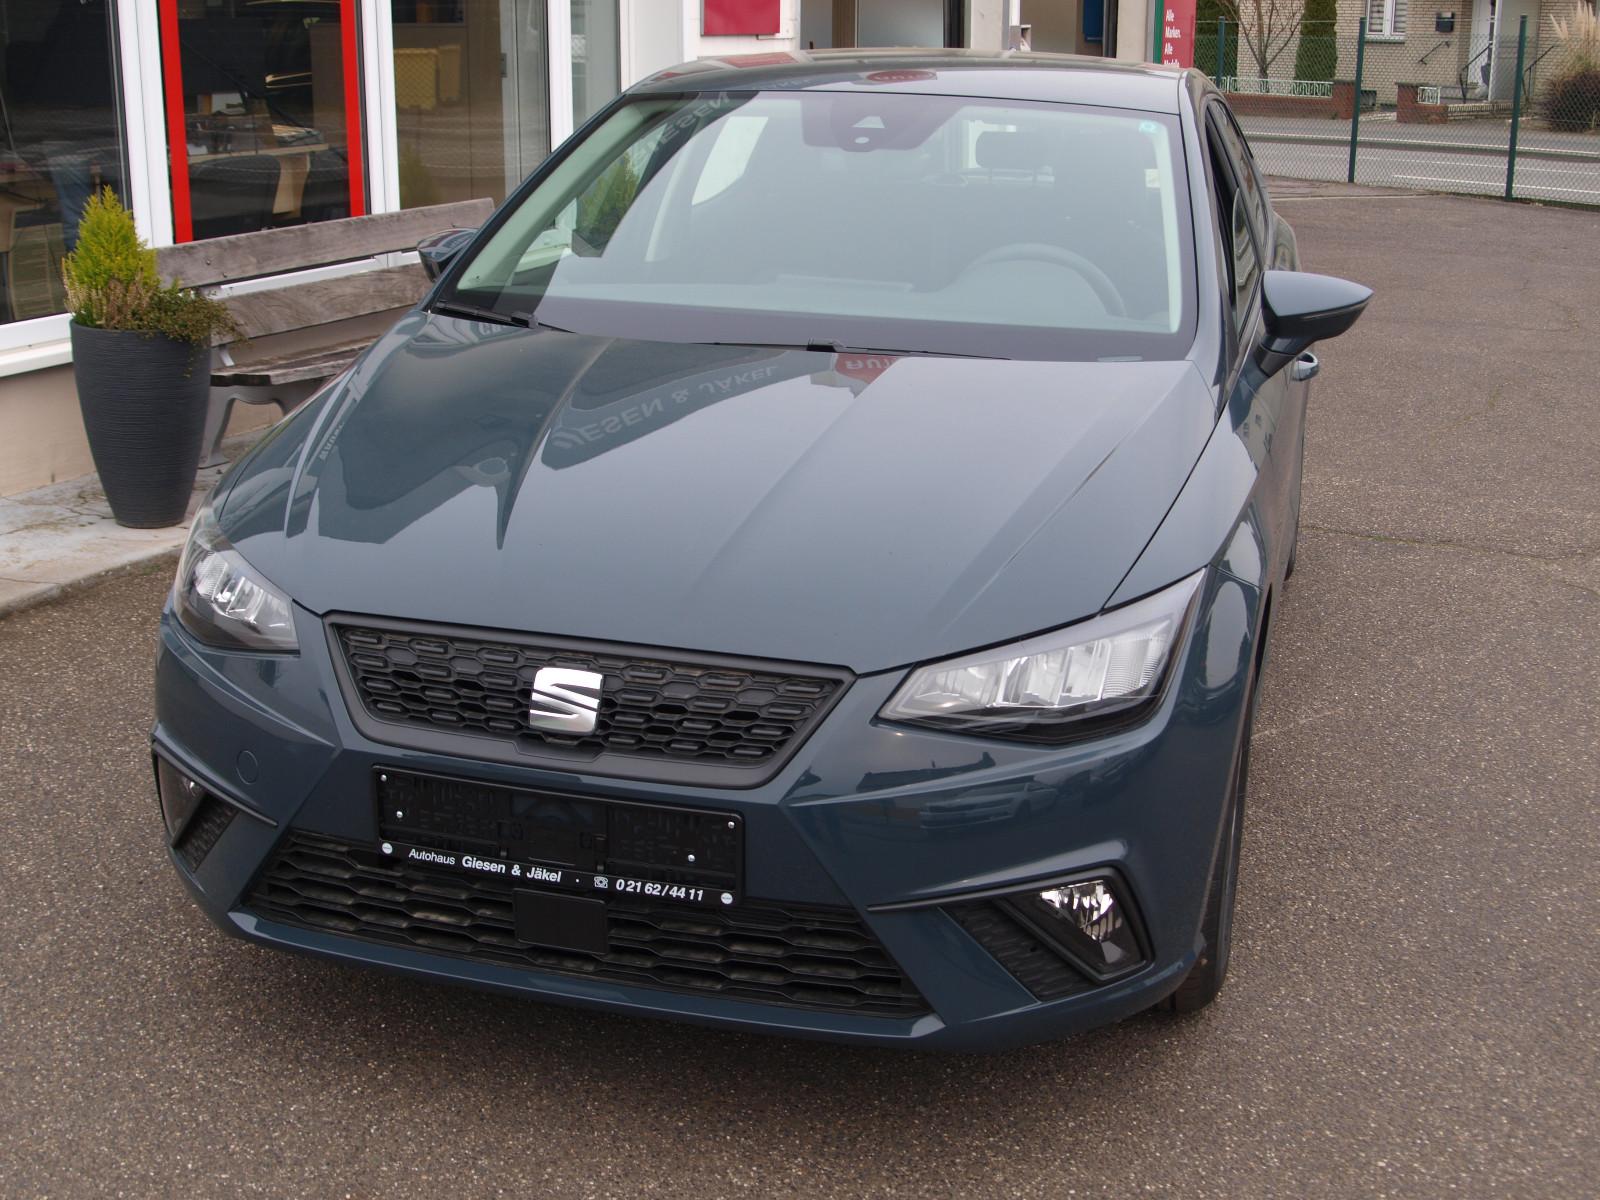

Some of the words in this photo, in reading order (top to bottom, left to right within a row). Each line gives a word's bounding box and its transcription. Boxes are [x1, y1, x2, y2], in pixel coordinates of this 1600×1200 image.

[408, 848, 456, 866] Autohaus
[461, 855, 506, 874] Giesen
[511, 864, 521, 876] &
[526, 866, 562, 883] Jäkel
